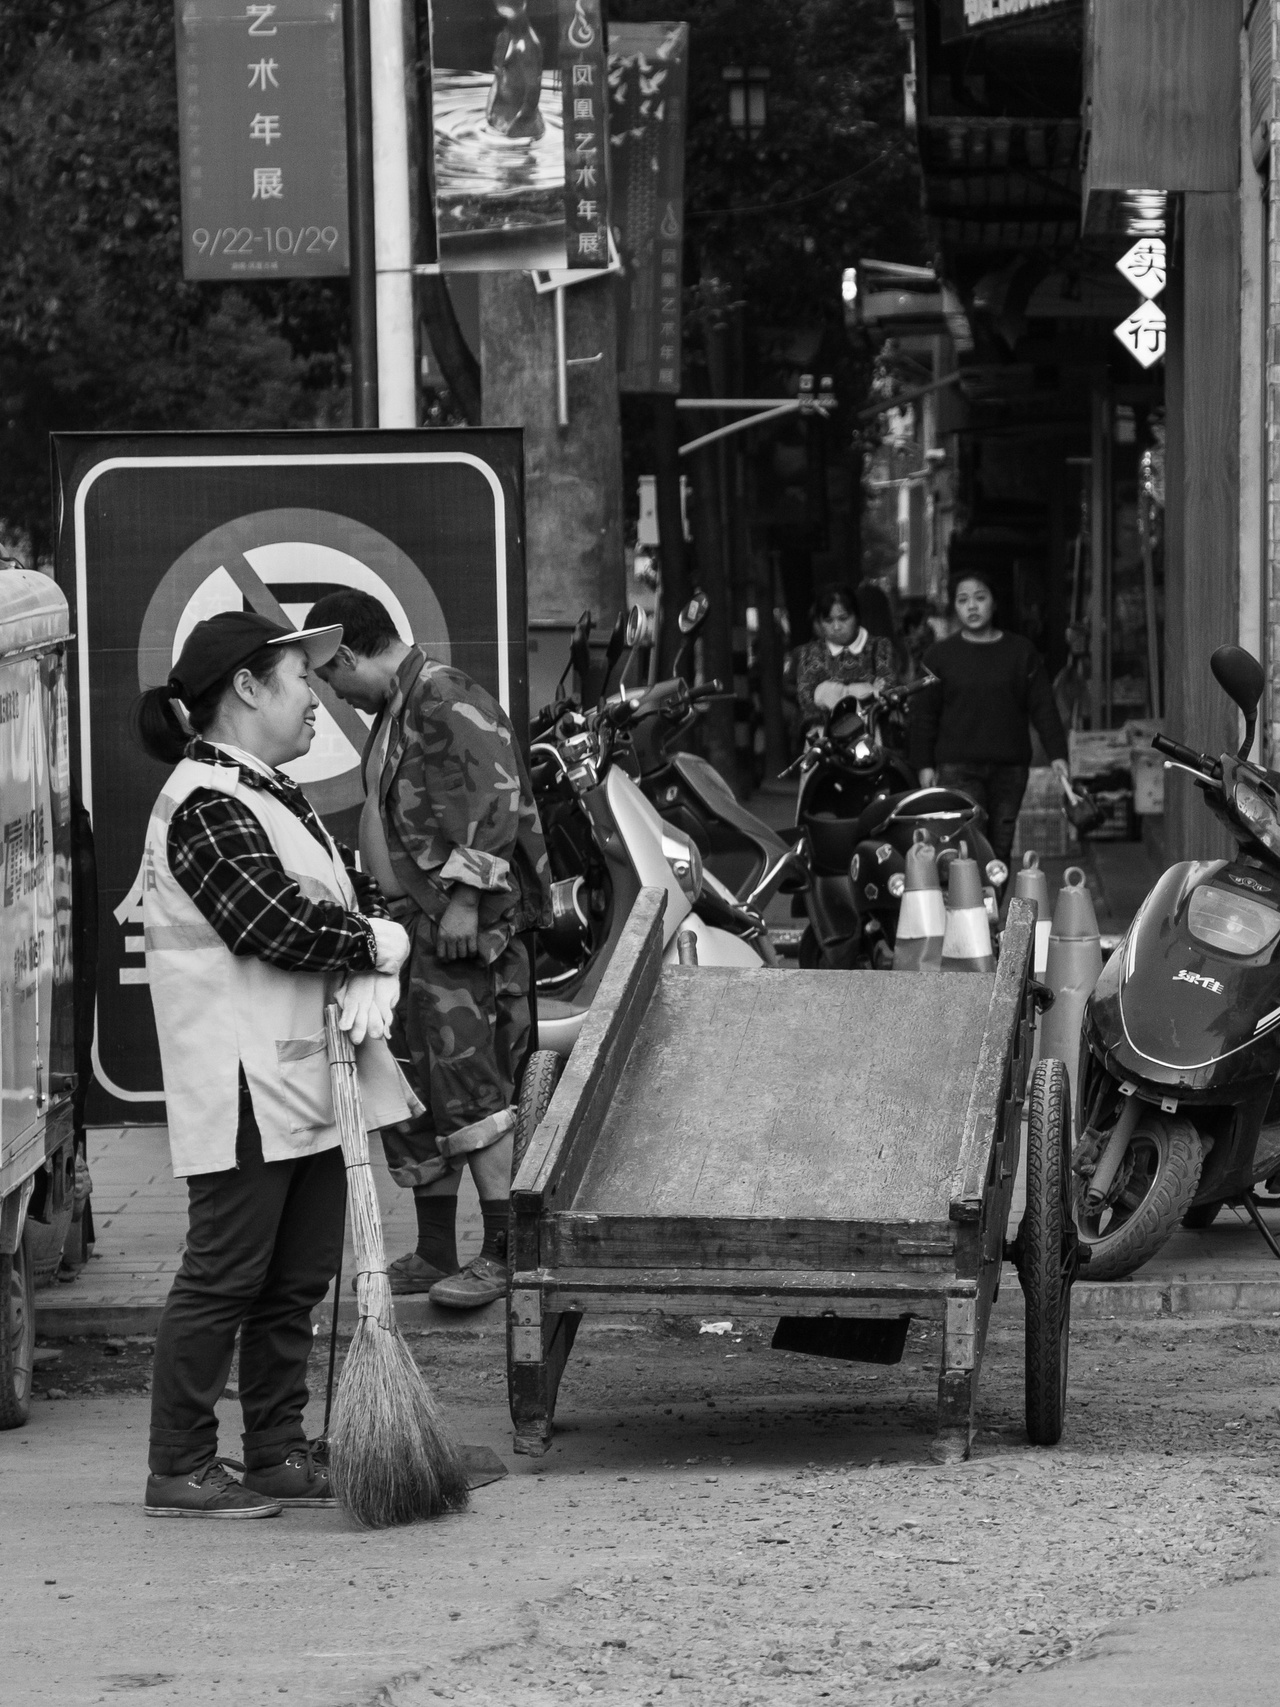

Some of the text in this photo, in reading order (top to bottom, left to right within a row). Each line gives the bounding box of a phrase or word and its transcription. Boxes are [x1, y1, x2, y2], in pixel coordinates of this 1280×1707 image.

[245, 4, 284, 200] 艺术年展
[572, 63, 600, 254] 凤凰艺术年展
[192, 226, 339, 257] 9/22-10/29
